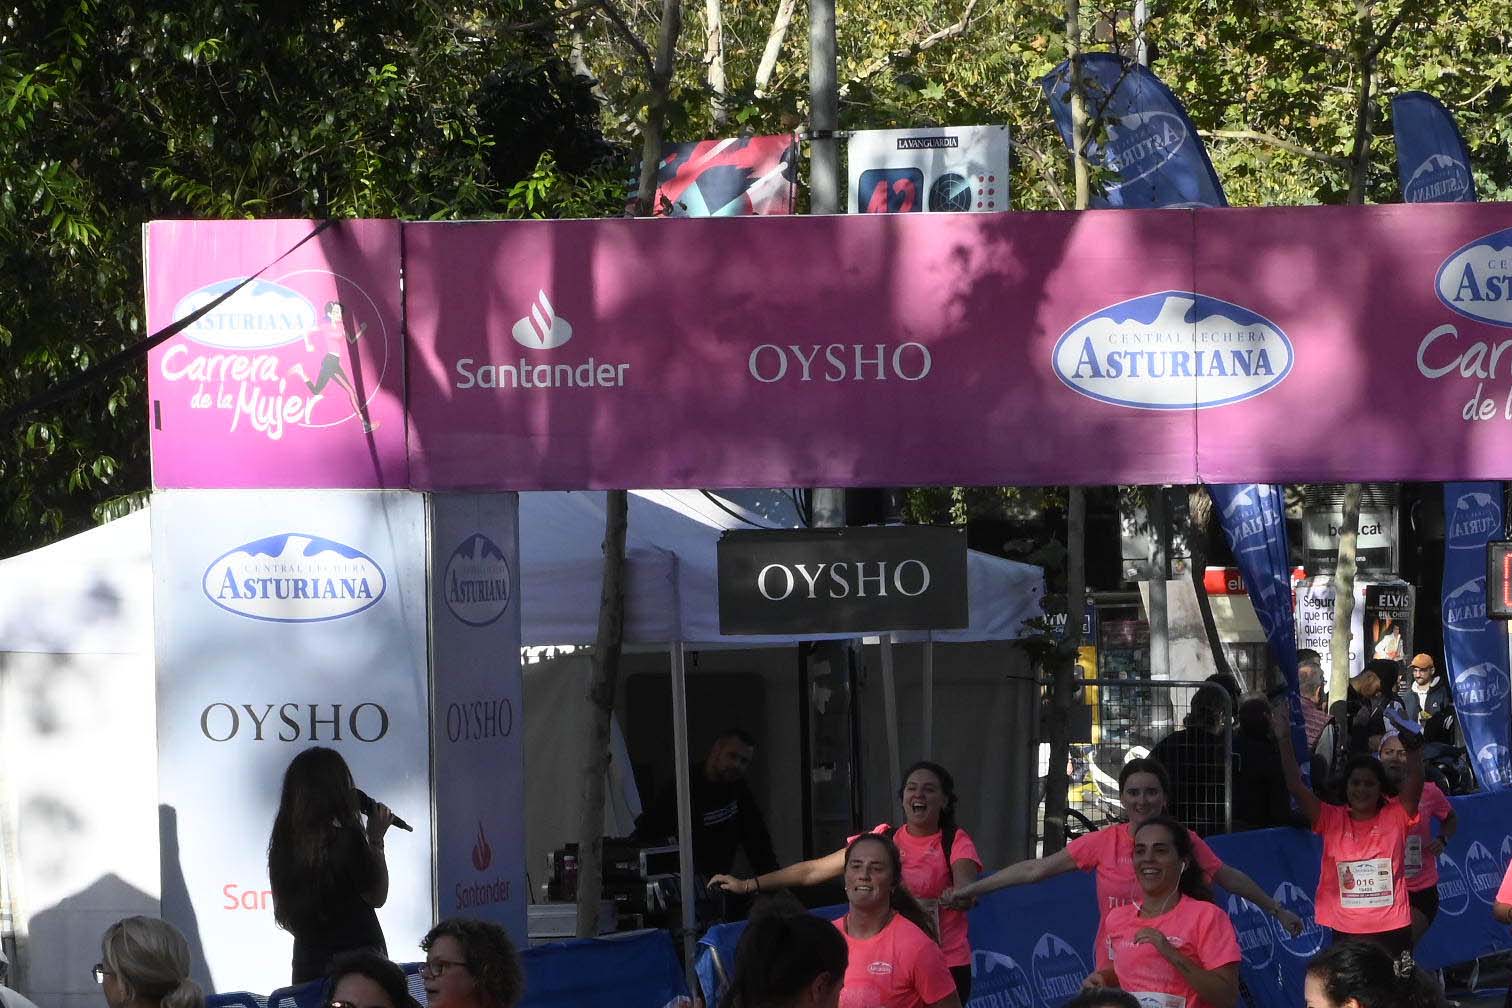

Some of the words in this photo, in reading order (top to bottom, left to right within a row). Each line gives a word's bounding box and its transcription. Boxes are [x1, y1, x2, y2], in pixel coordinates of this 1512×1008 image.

[1107, 331, 1183, 345] CENTRAL
[1193, 331, 1267, 343] LECHERA
[160, 344, 280, 382] Carrera
[455, 357, 630, 389] Santander
[748, 342, 932, 383] OYSHO
[1071, 337, 1276, 379] ASTURIANA
[190, 386, 215, 409] de
[216, 382, 233, 409] la
[230, 378, 323, 440] Mujer
[1462, 383, 1497, 421] de
[217, 566, 373, 600] ASTURIANA
[450, 568, 507, 604] ASTURIANA
[757, 559, 931, 601] OYSHO
[1379, 594, 1409, 607] ELVIS
[200, 702, 390, 743] OYSHO
[446, 698, 513, 743] OYSHO
[455, 878, 512, 912] Santander
[1356, 878, 1376, 887] 016
